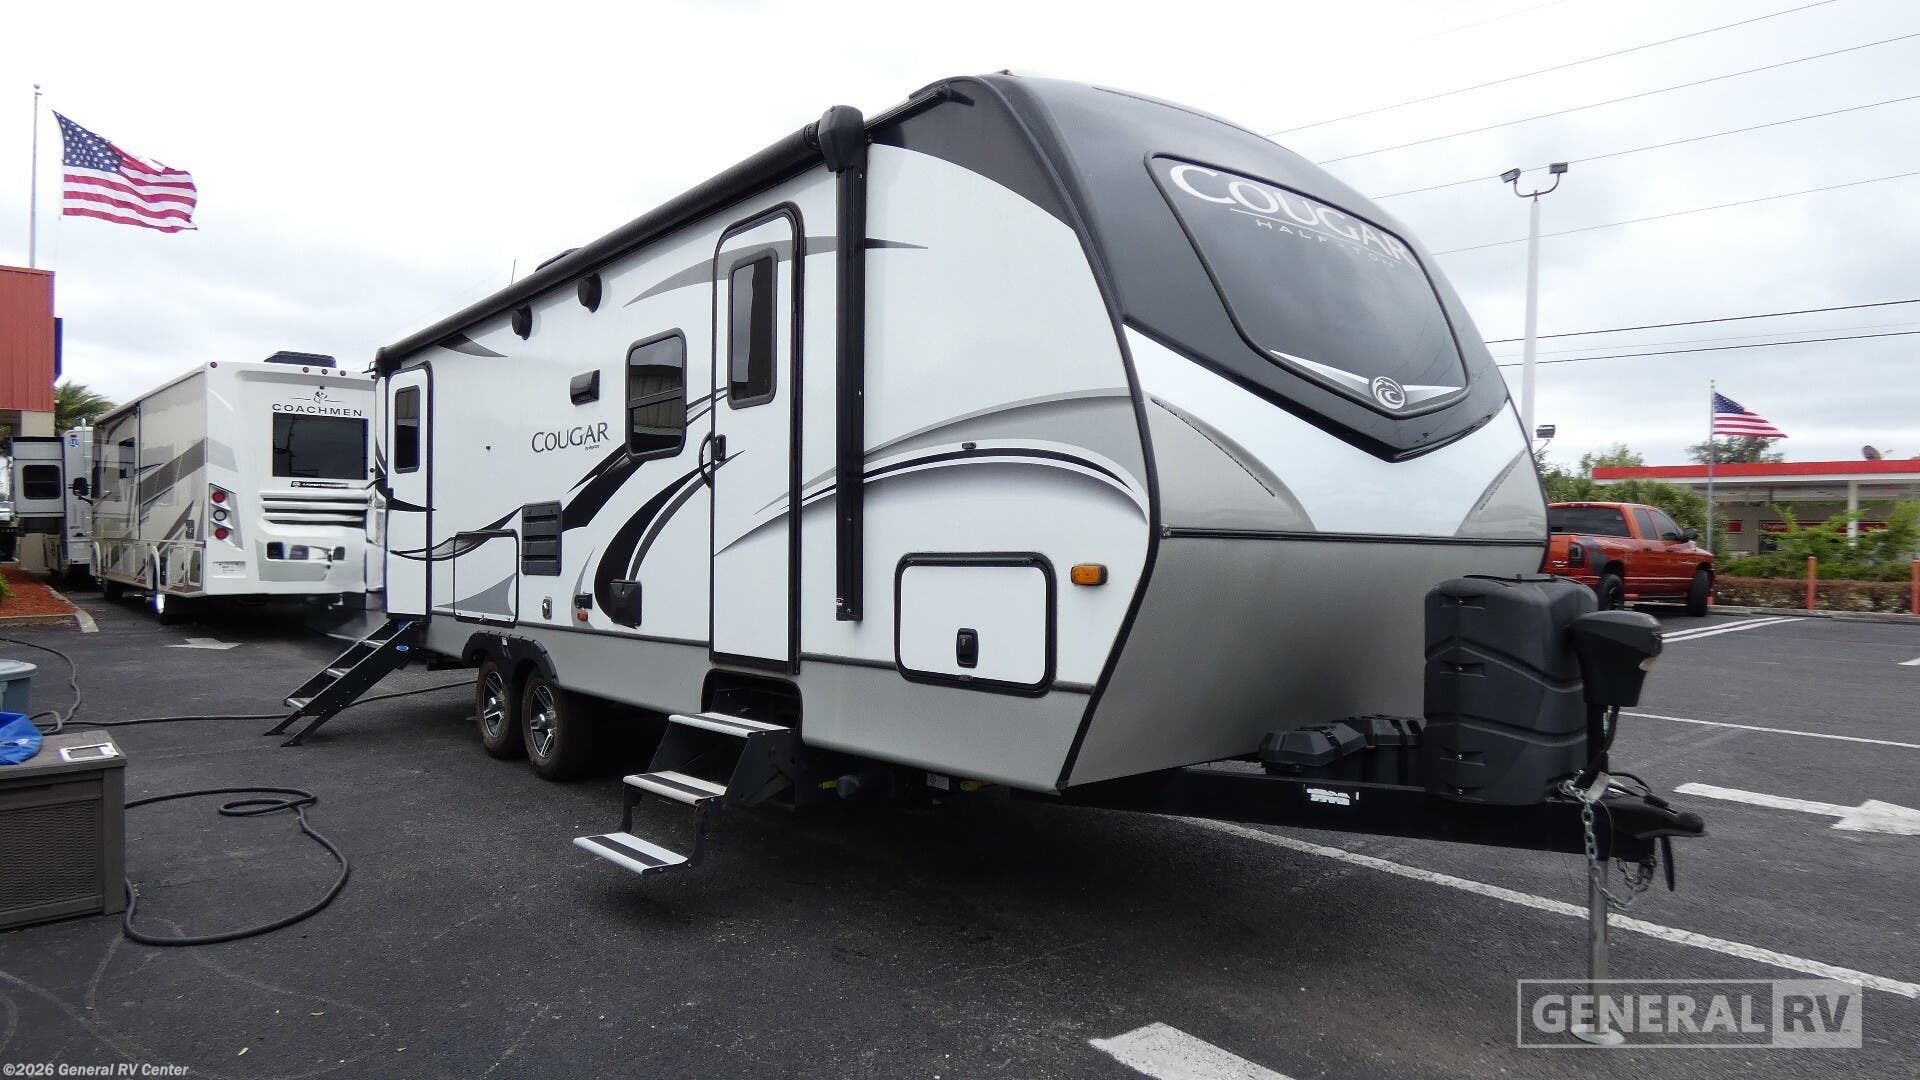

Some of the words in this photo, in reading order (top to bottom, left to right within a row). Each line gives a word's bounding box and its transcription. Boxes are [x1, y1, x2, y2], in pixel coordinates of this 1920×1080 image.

[1170, 164, 1420, 271] COUGAR
[272, 403, 363, 417] COACHMEN
[531, 422, 611, 453] COUGAR
